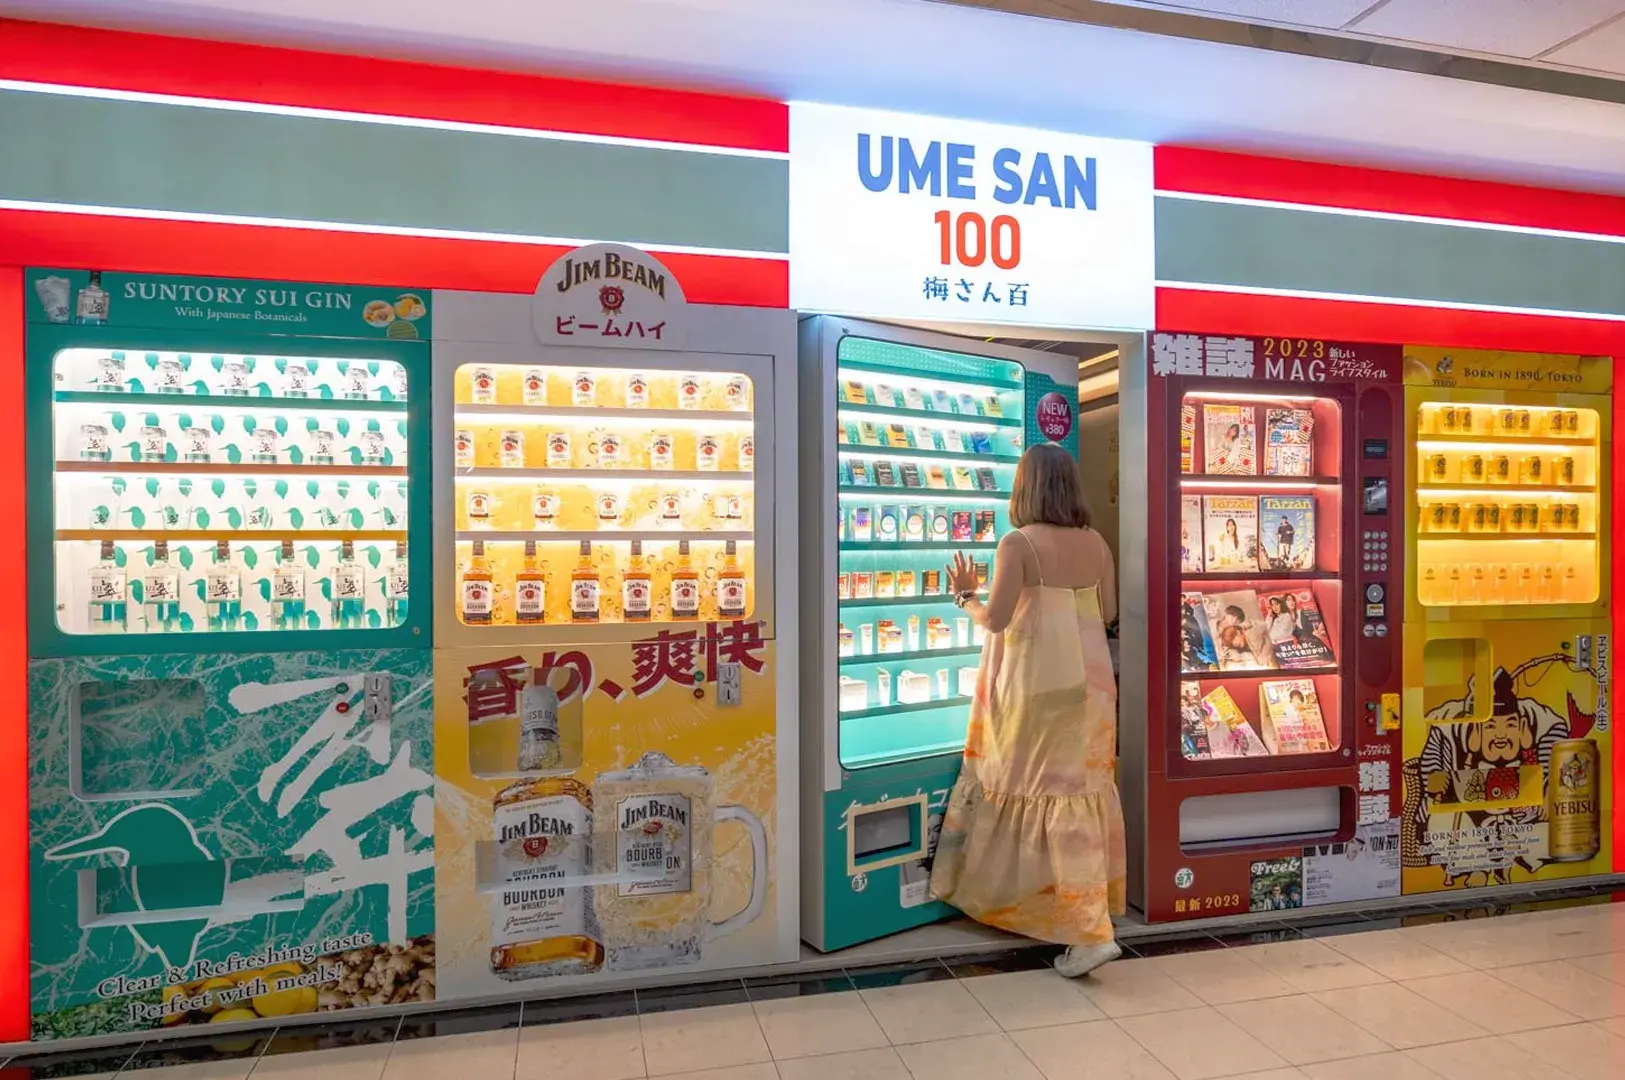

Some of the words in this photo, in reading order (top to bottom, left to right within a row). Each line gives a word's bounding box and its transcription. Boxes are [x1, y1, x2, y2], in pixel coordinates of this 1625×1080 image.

[857, 133, 976, 200] UME
[993, 147, 1097, 211] SAN
[934, 210, 1021, 270] 100
[557, 259, 601, 293] JIM
[605, 252, 665, 301] BEAM
[124, 281, 249, 305] SUNTORY
[255, 288, 298, 307] SUI
[305, 291, 352, 310] GIN
[923, 276, 1030, 307] 梅さん百
[175, 306, 203, 319] With
[206, 308, 251, 322] Japanese
[253, 311, 308, 324] Botanicals
[556, 315, 666, 340] ビームハイ
[1151, 333, 1256, 378] 雑誌
[1263, 338, 1324, 358] 2023
[1329, 347, 1356, 359] 新しい
[1265, 358, 1326, 382] MAG
[1330, 367, 1389, 379] ライフスタイル
[1464, 367, 1495, 379] BORN
[1499, 371, 1511, 379] IN
[1547, 372, 1583, 383] TOKYO
[1043, 401, 1068, 417] NEW
[1210, 497, 1256, 510] Tarzan
[1264, 498, 1313, 510] Tarzan
[621, 806, 647, 829] JIM
[649, 800, 686, 826] BEAM
[1554, 800, 1597, 816] YEBISU
[499, 819, 527, 844] JIM
[529, 813, 573, 836] BEAM
[1424, 831, 1453, 842] BORN
[1501, 824, 1534, 835] TOKYO
[1251, 859, 1301, 876] Free&
[1175, 898, 1201, 913] 最新
[1205, 894, 1240, 909] 2023
[98, 974, 161, 999] Clear
[167, 966, 188, 984] &
[193, 942, 316, 979] Refreshing
[322, 930, 373, 952] taste
[127, 992, 212, 1023] Perfect
[219, 978, 269, 1006] with
[277, 963, 344, 991] meals!
